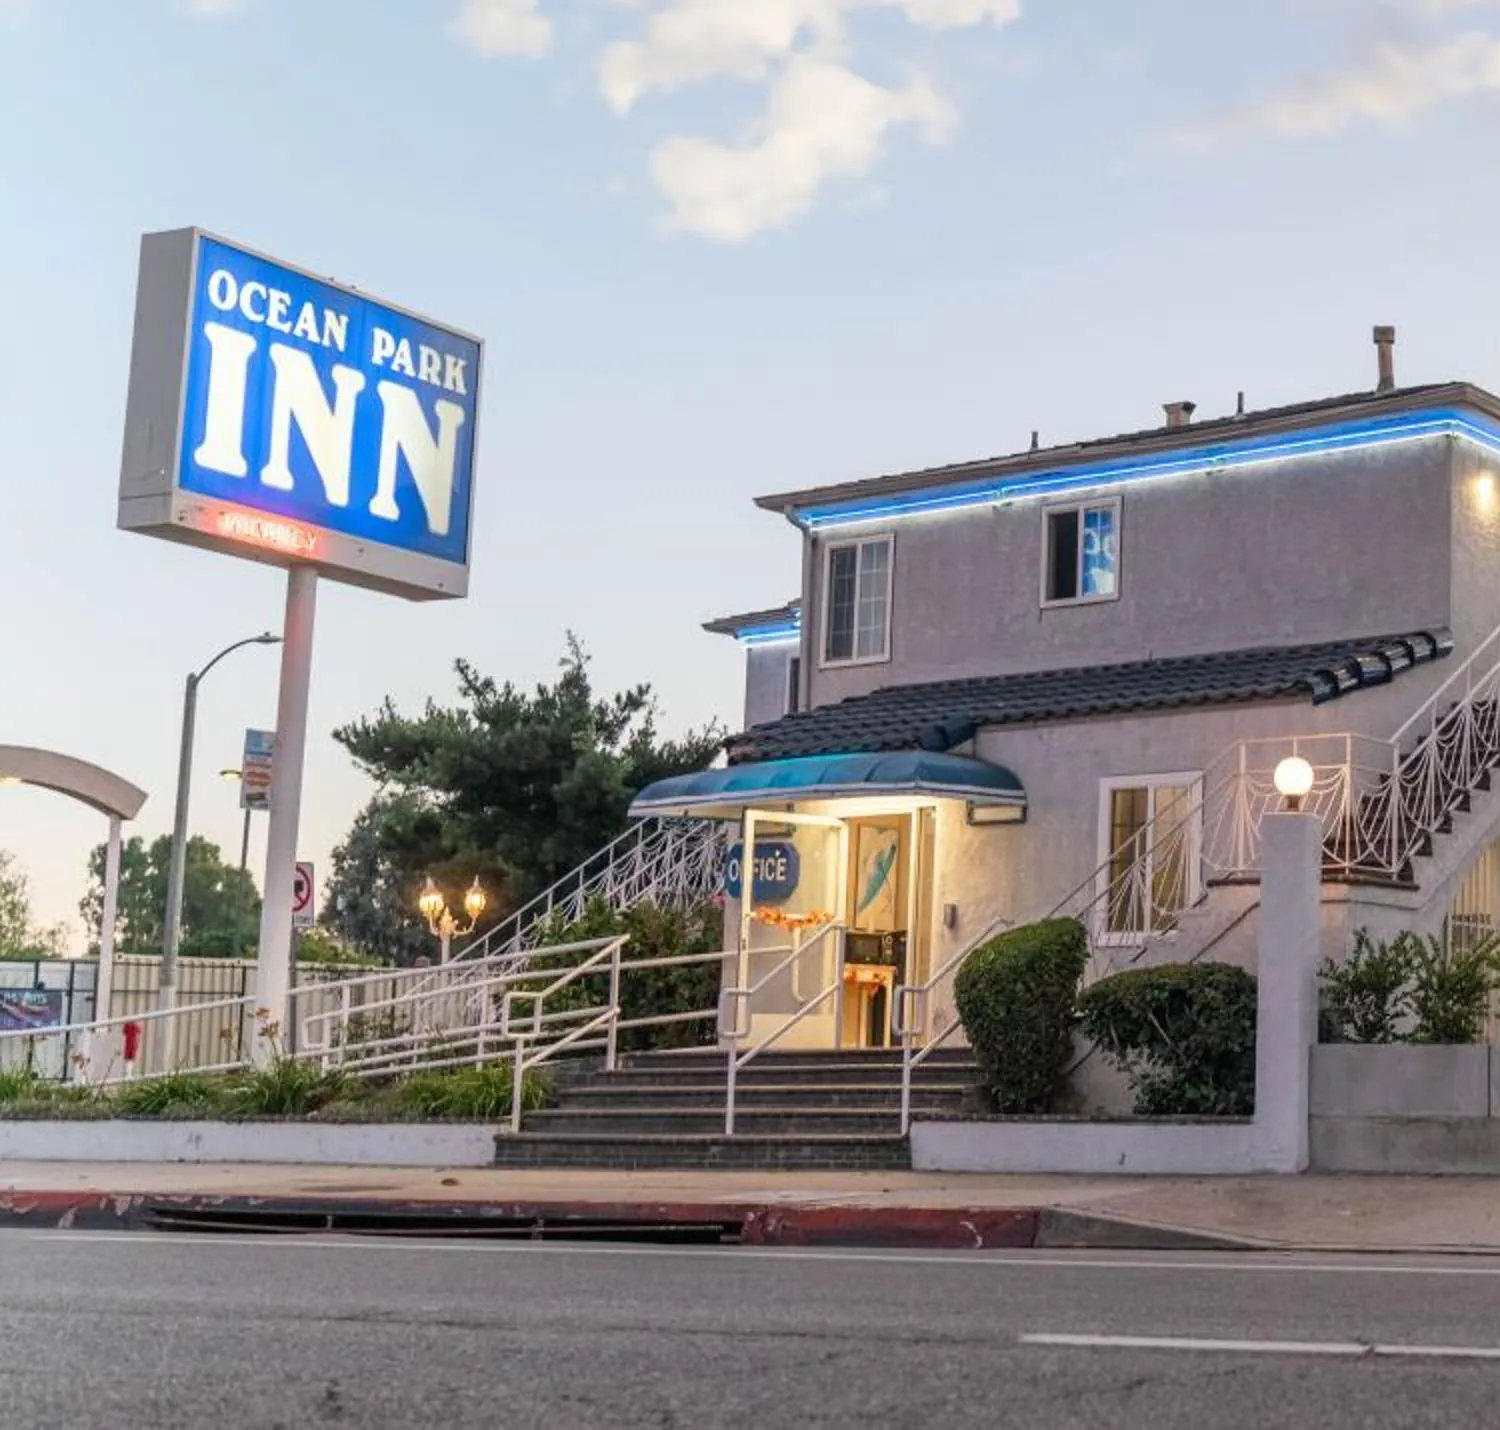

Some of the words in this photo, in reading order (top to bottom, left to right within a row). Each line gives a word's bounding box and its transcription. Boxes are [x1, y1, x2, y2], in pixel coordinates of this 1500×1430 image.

[208, 269, 349, 352] OCEAN
[371, 327, 467, 396] PARK
[193, 321, 465, 535] INN
[728, 857, 787, 882] OFICE
